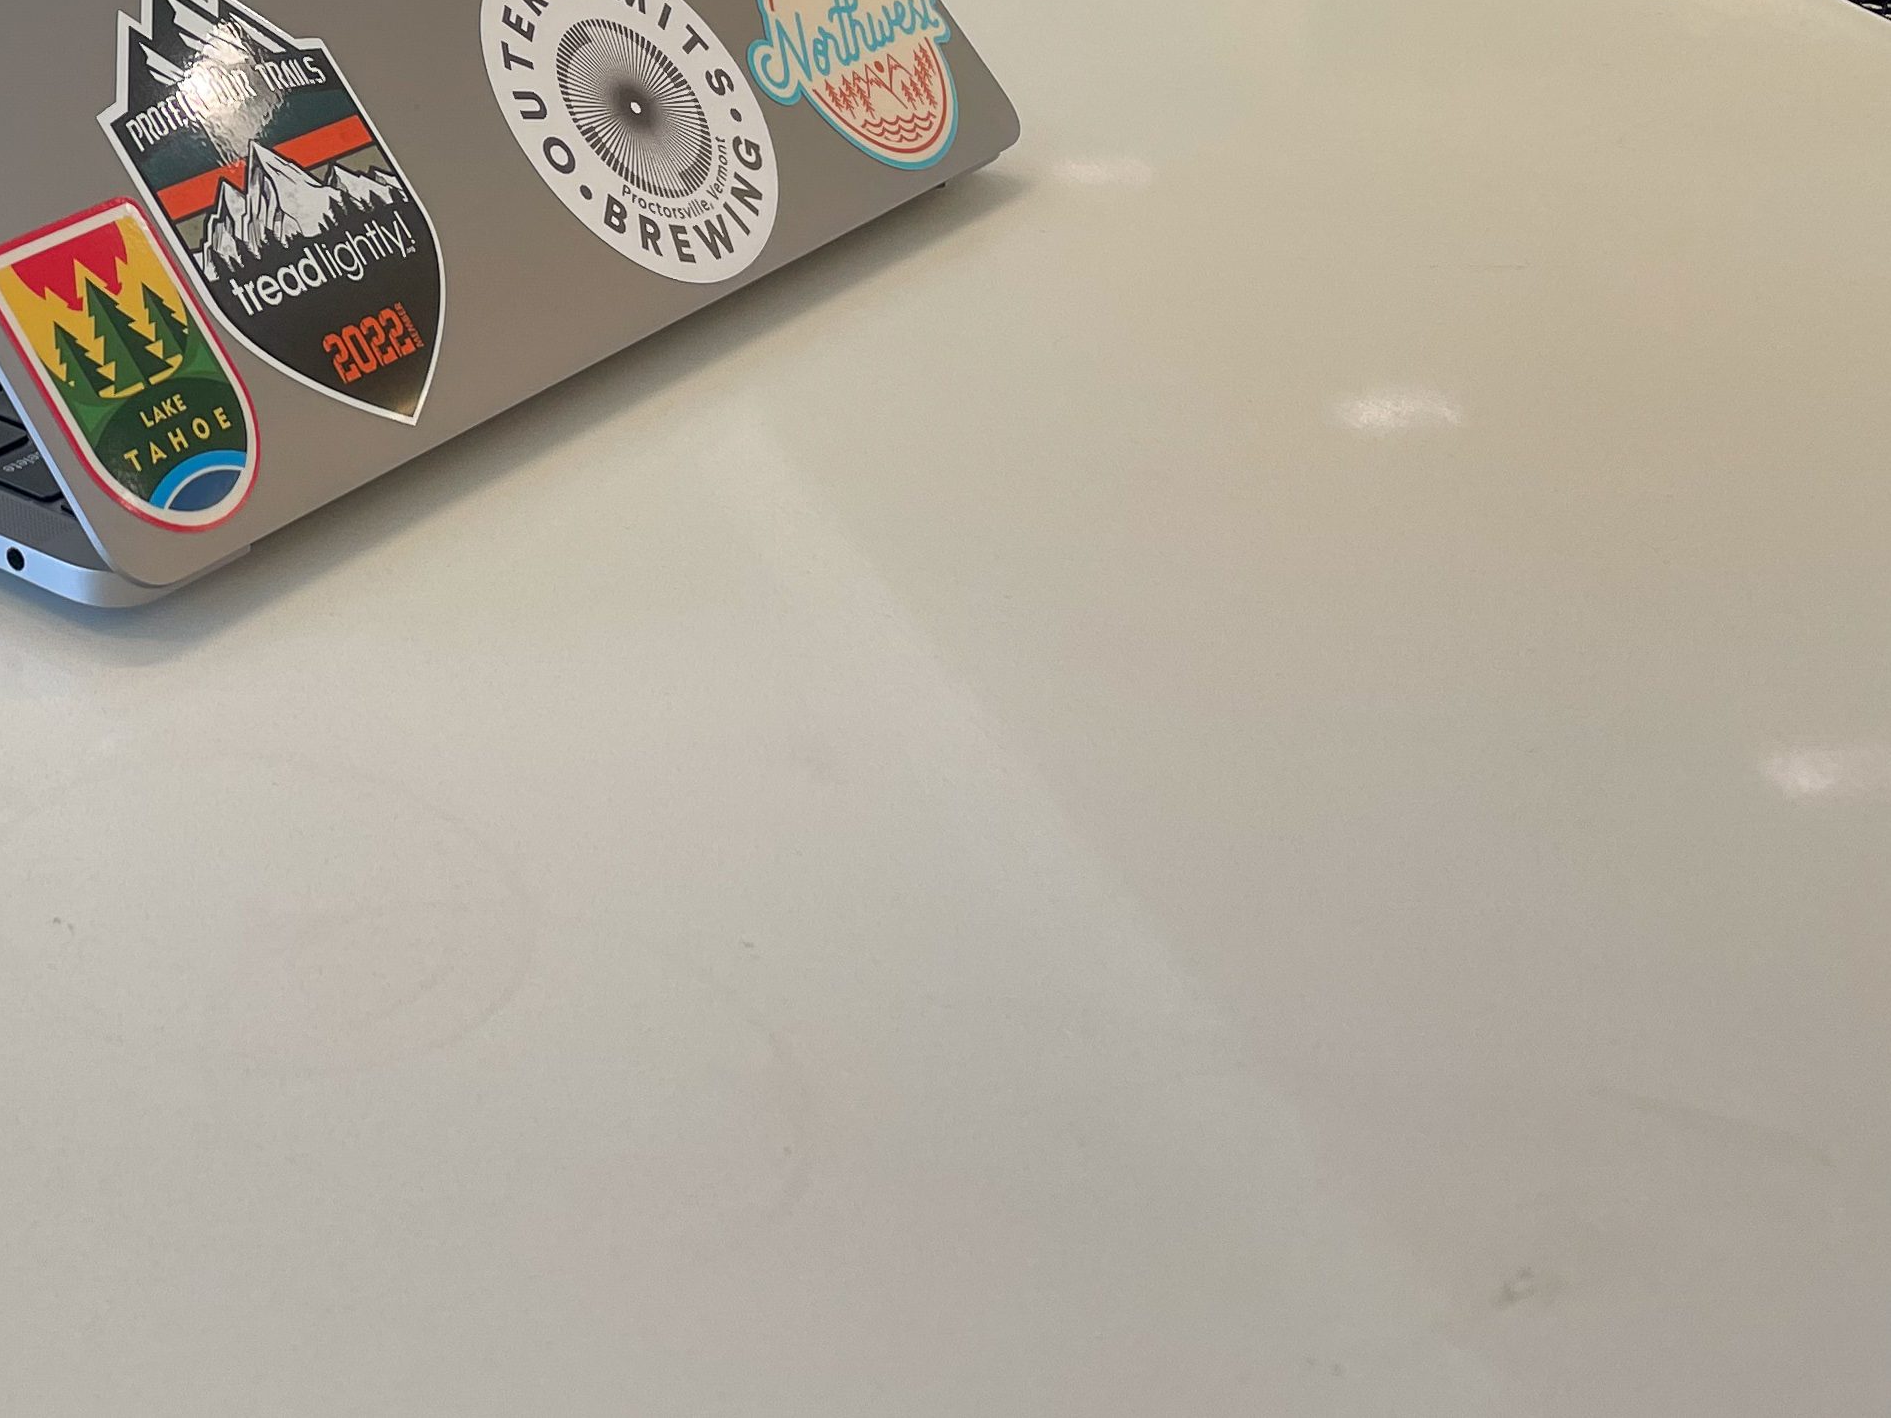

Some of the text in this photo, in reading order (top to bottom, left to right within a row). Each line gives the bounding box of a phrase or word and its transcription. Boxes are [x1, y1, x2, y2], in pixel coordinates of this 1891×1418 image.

[126, 82, 208, 153] PROTEC
[254, 55, 328, 92] TRAILS
[603, 135, 763, 264] BREWING
[709, 135, 728, 201] Vermont
[322, 307, 417, 384] 2022
[122, 406, 232, 473] TAHOE
[139, 393, 188, 429] LAKE
[2, 451, 40, 472] elete
